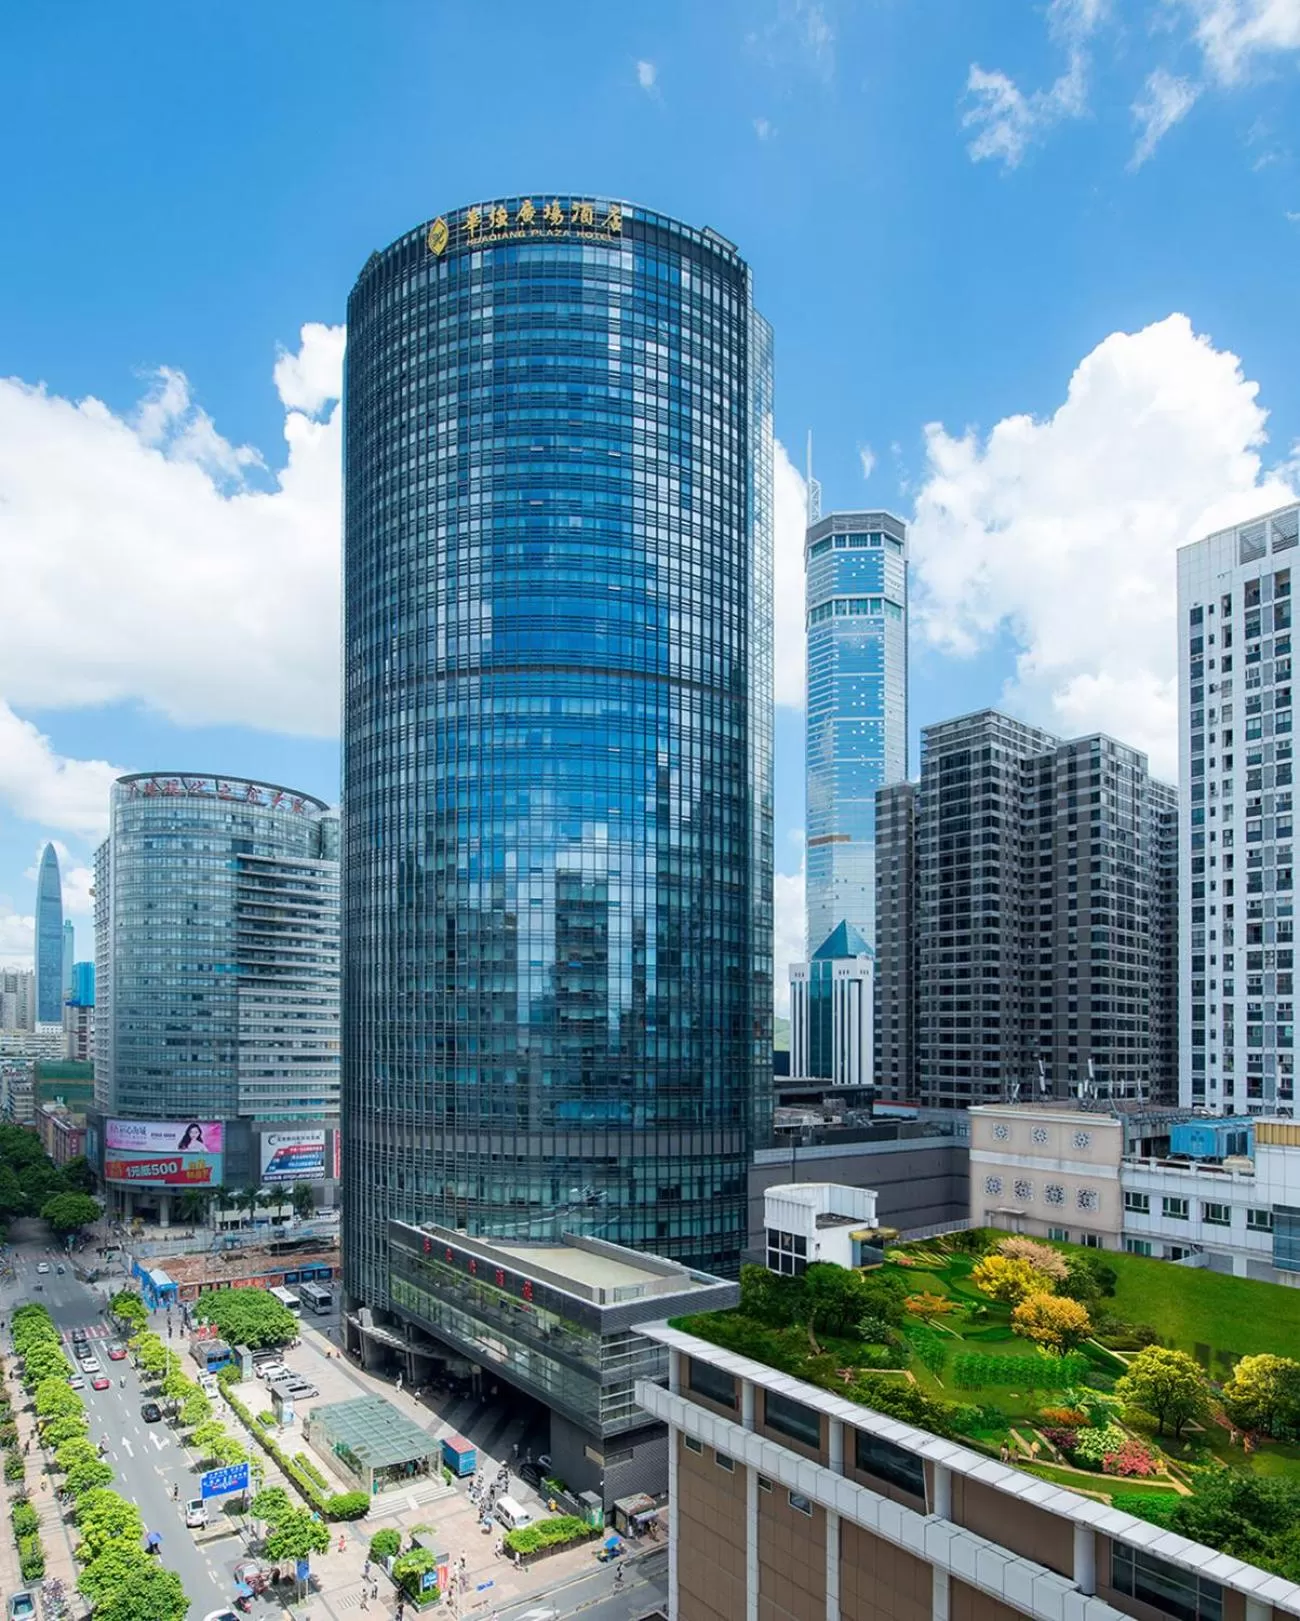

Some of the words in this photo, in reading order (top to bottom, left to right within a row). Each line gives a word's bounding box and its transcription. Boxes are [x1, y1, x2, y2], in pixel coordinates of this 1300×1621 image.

[467, 230, 526, 246] HUAQIANG
[531, 229, 571, 238] PLAZA
[576, 230, 616, 243] HOTEL
